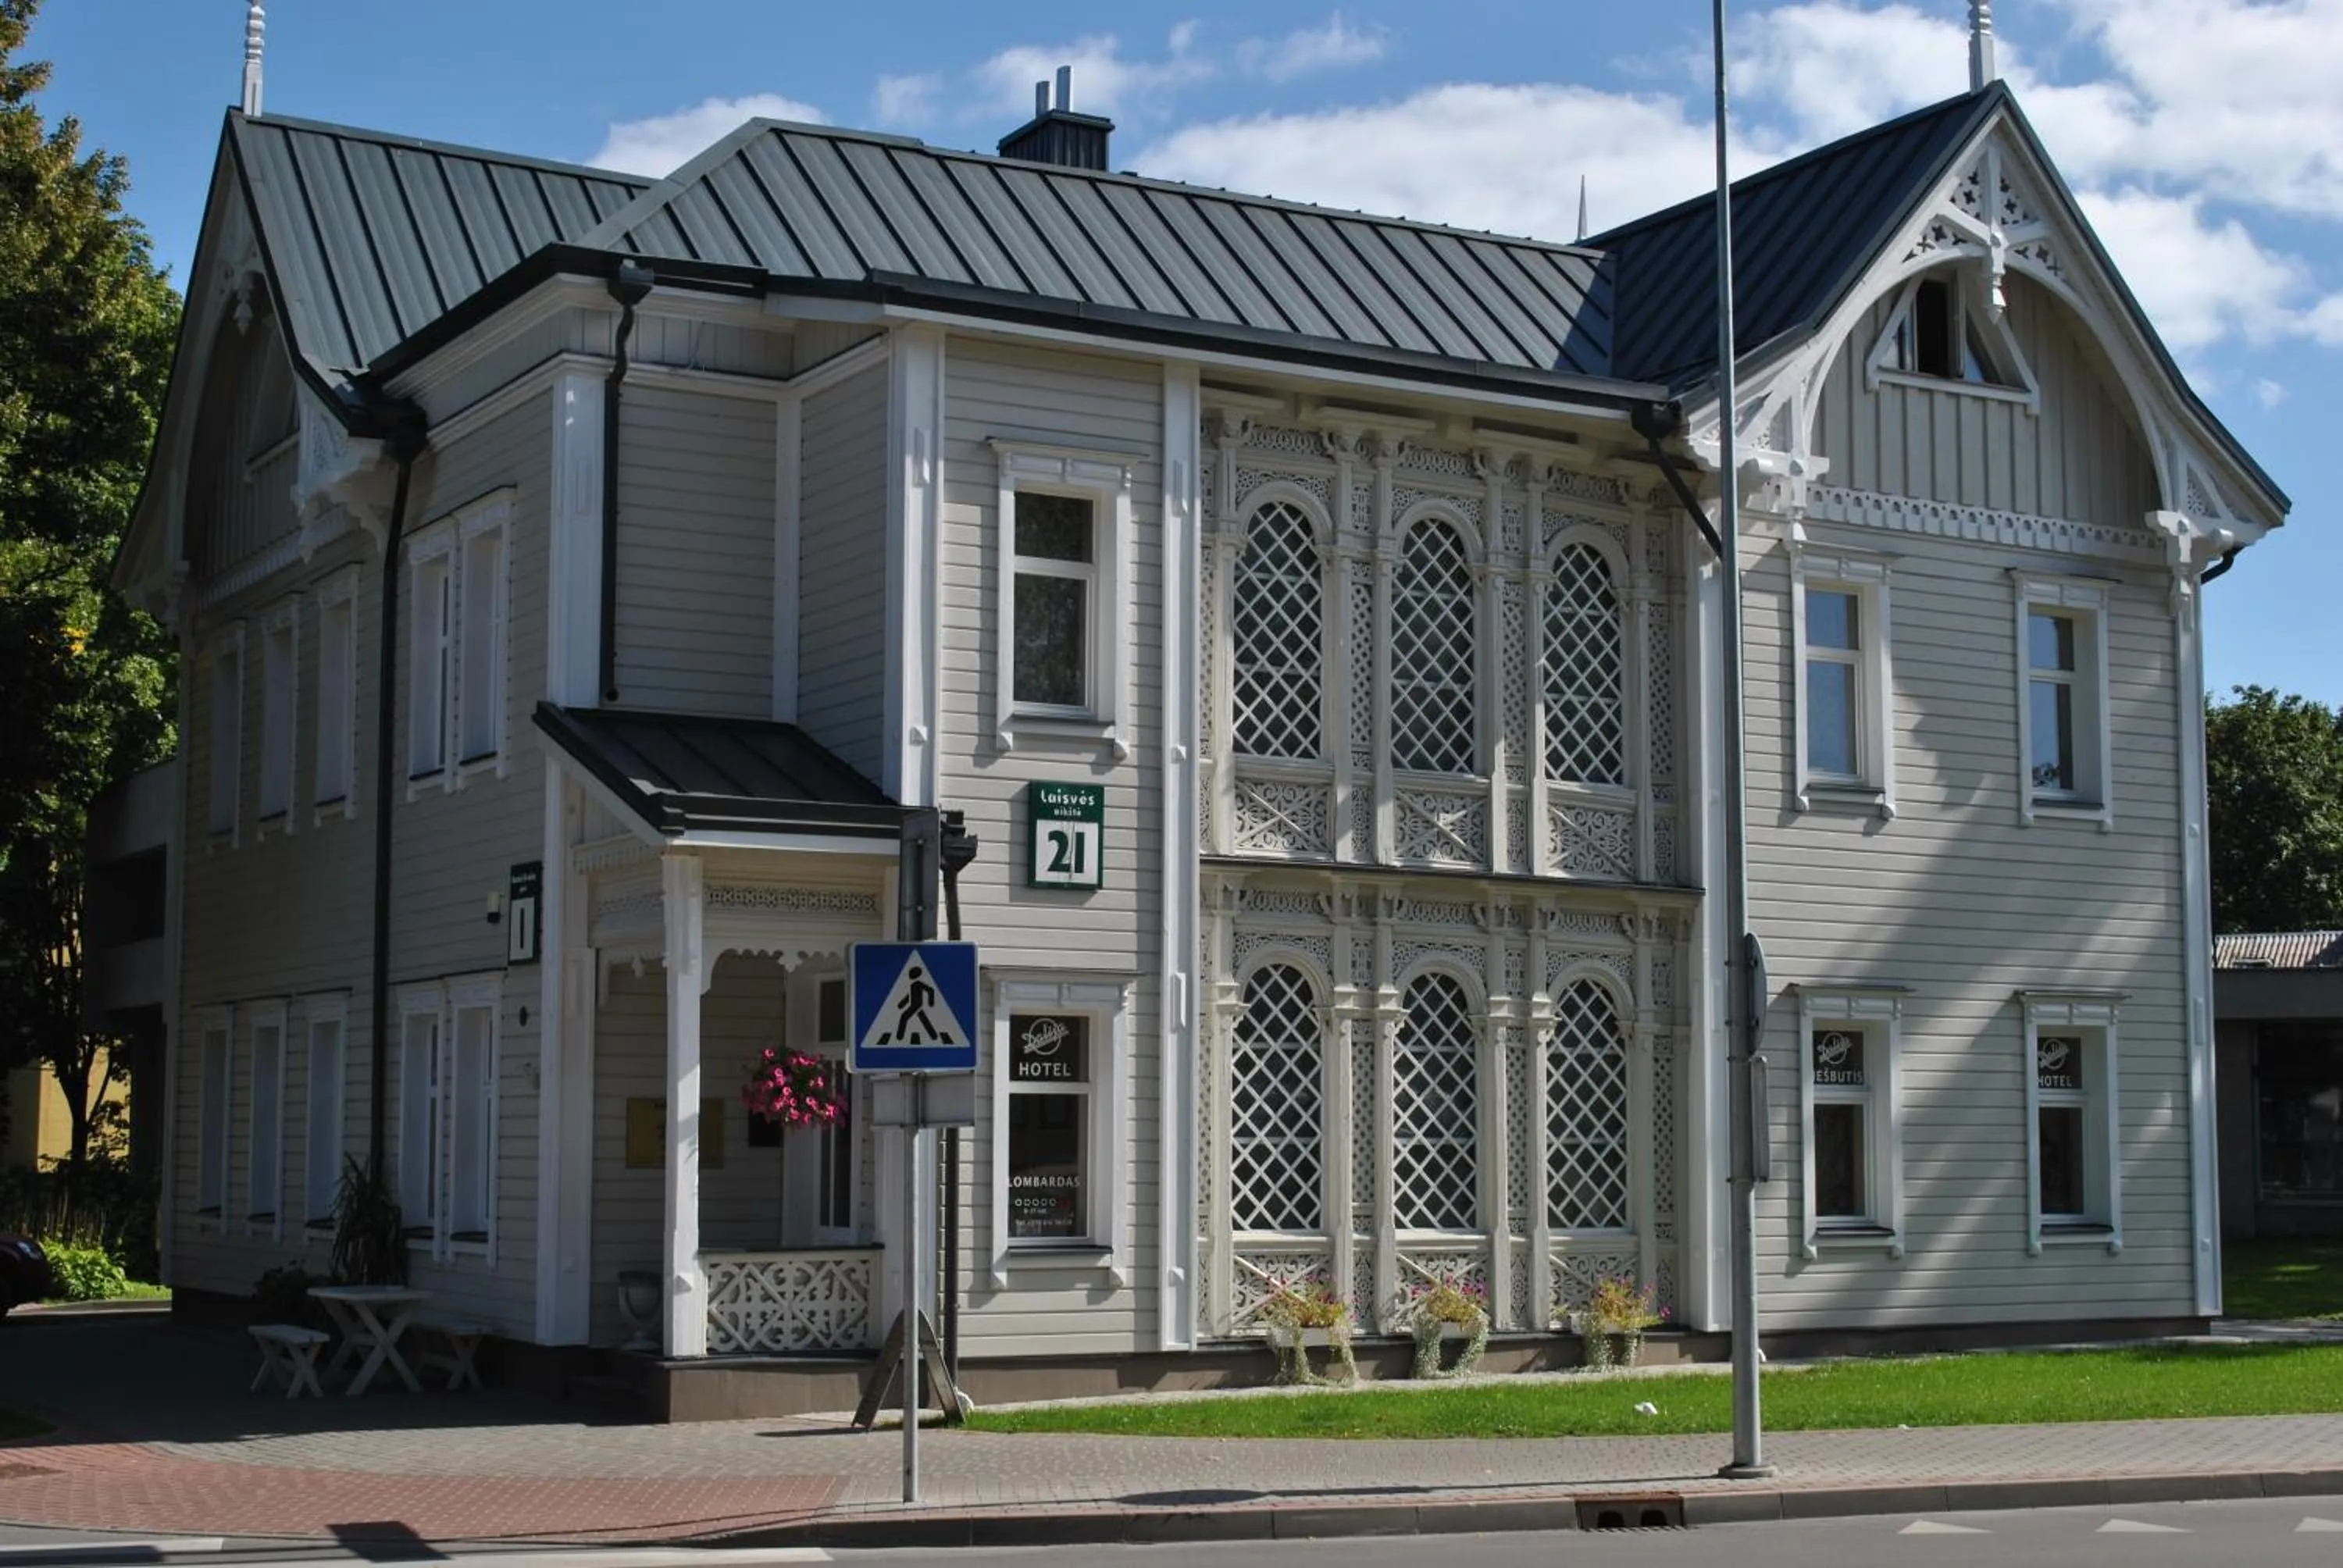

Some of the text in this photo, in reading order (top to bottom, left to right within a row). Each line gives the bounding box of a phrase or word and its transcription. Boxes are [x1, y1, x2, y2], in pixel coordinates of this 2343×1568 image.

[1040, 788, 1095, 805] Laisvės
[1047, 830, 1085, 873] 21
[519, 907, 524, 950] 1
[1018, 1061, 1071, 1076] HOTEL
[2037, 1074, 2072, 1087] HOTEL
[1007, 1175, 1080, 1187] LOMBARDAS
